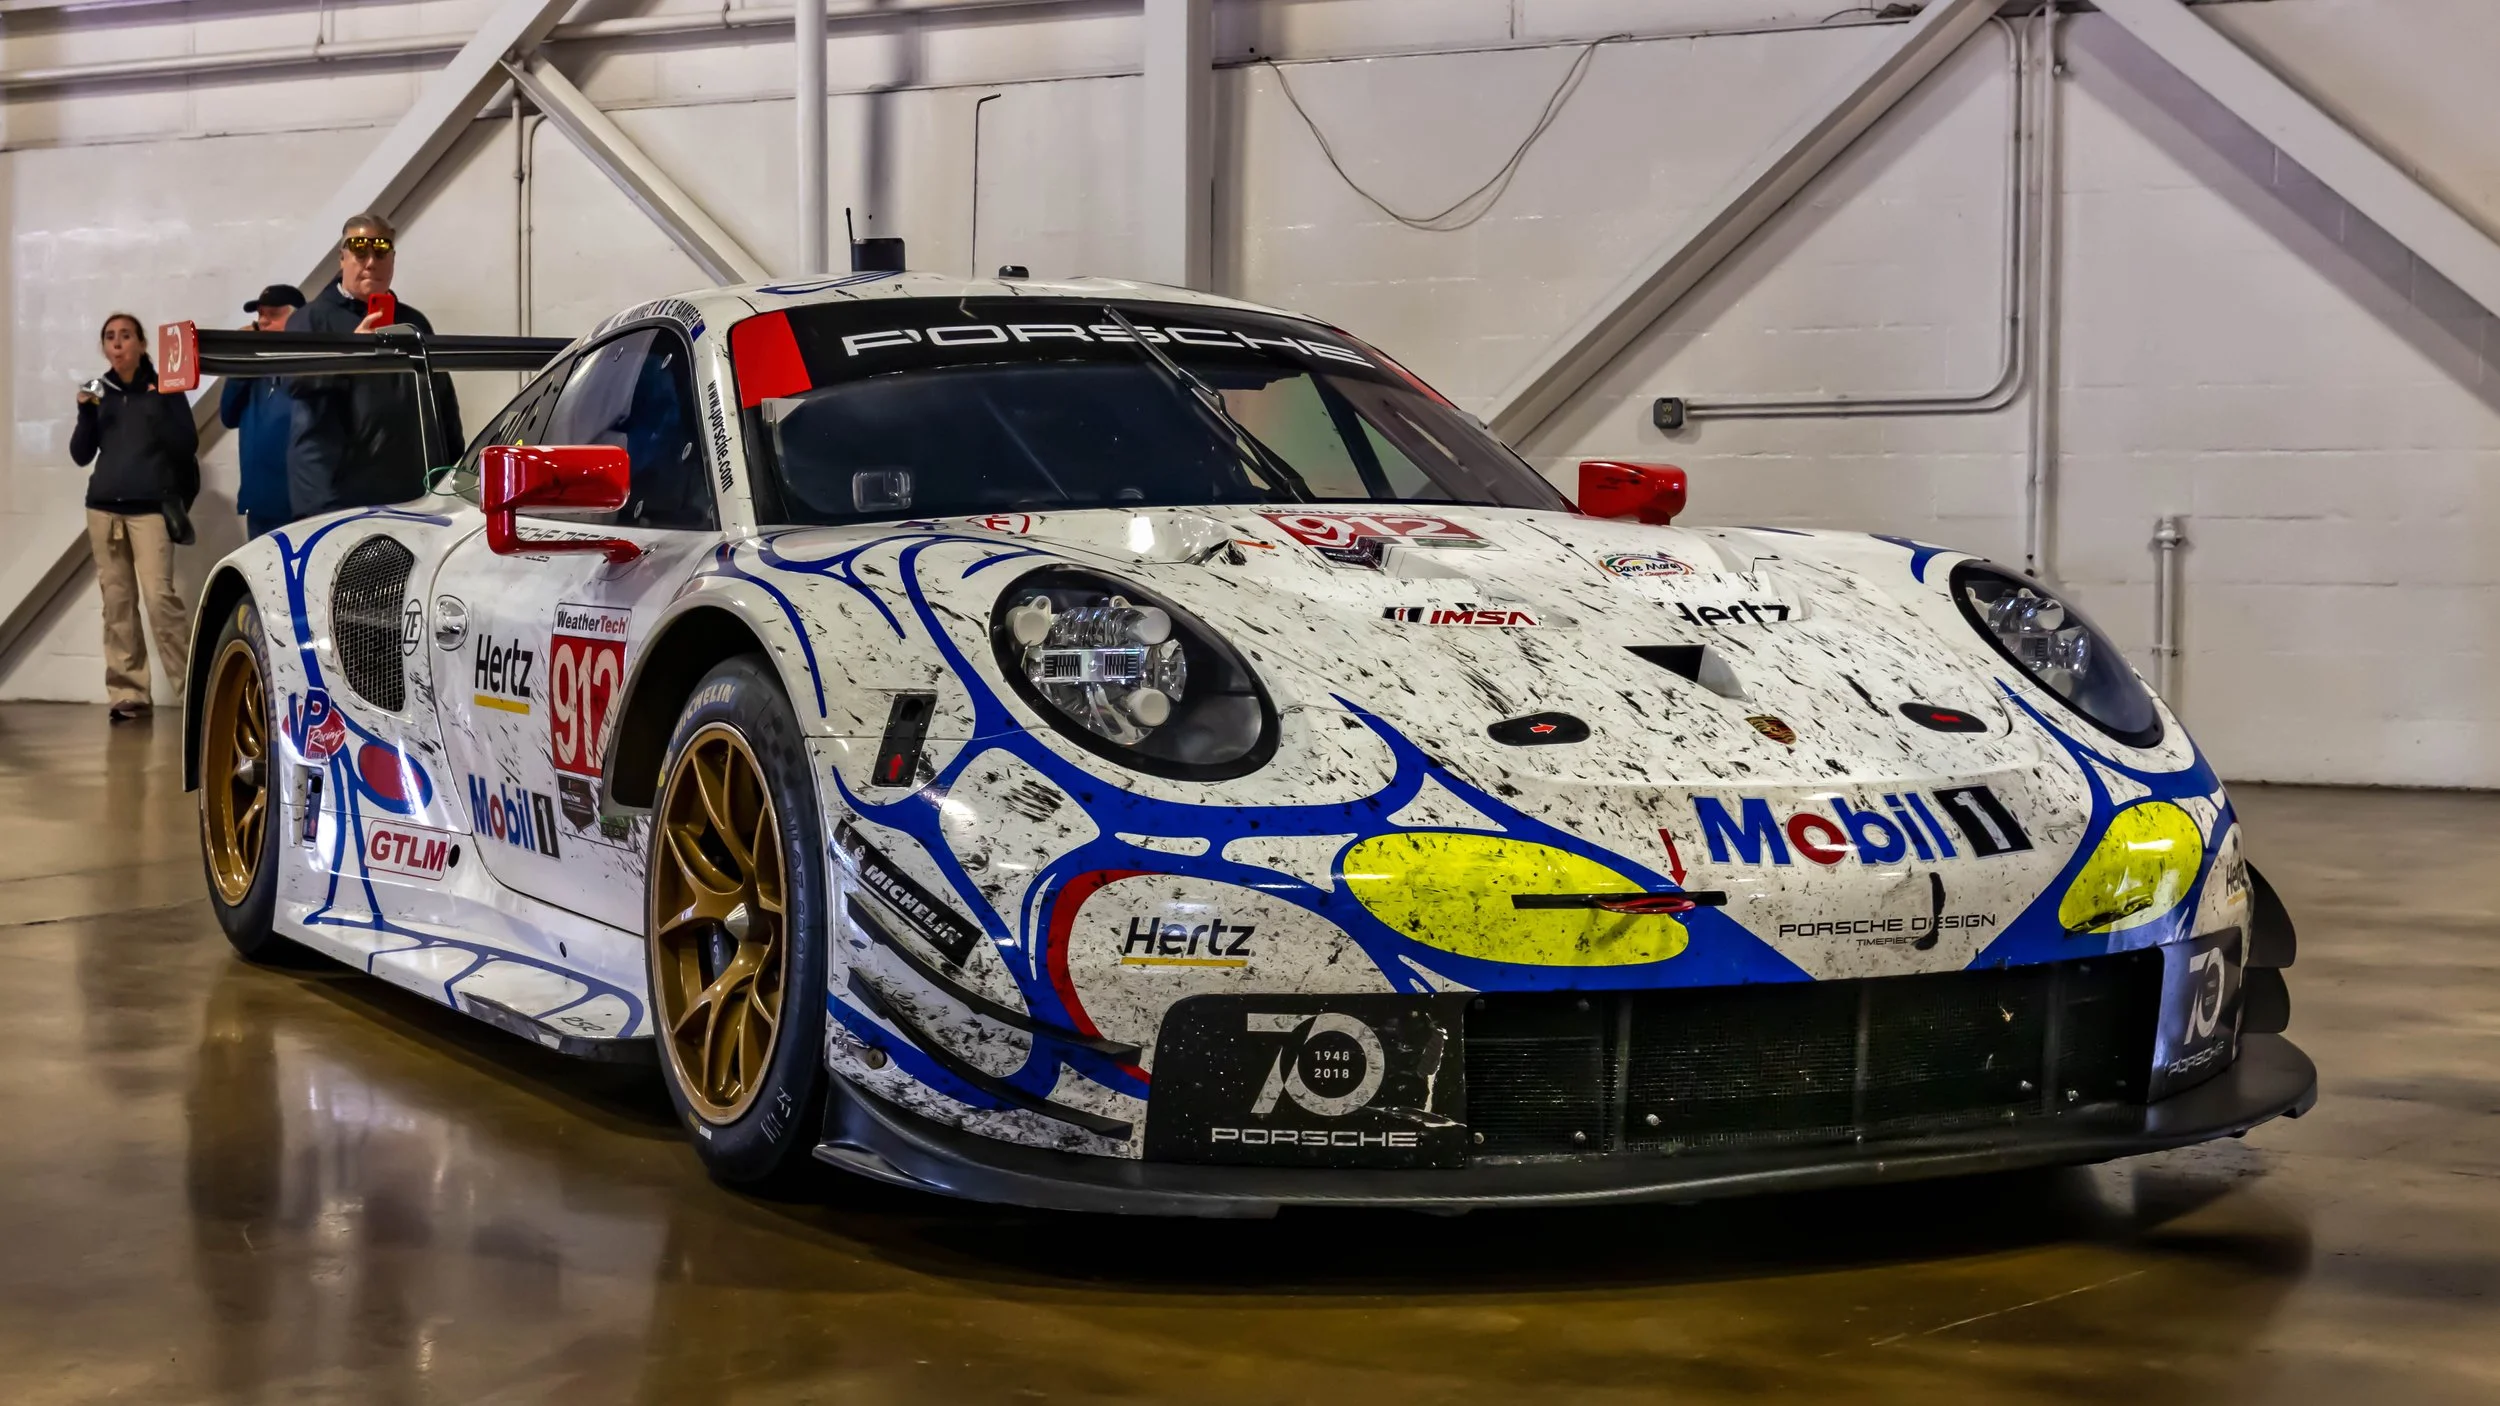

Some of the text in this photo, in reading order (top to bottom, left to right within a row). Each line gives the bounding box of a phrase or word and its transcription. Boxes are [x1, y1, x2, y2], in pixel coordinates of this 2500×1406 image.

[841, 324, 1376, 368] PORSCHE
[708, 380, 734, 493] www.porsche.com
[1278, 515, 1477, 547] 912
[403, 611, 422, 644] ZF
[557, 611, 629, 635] WeatherTech
[1430, 610, 1537, 626] IMSA
[475, 634, 533, 698] Hertz
[551, 643, 620, 770] 912
[673, 683, 733, 745] MICHELIN
[309, 728, 346, 751] Racing
[468, 774, 536, 852] Mobil
[1693, 787, 2024, 866] Mobil 1
[370, 831, 447, 872] GTLM
[864, 864, 963, 945] MICHELIN
[1124, 917, 1255, 957] Hertz
[1779, 914, 1996, 938] PORSCHE DESIGN
[2184, 946, 2225, 1045] 70
[1247, 1012, 1385, 1116] 70
[1314, 1050, 1350, 1061] 1948
[1314, 1068, 1350, 1079] 2018
[1211, 1127, 1418, 1148] PORSCHE
